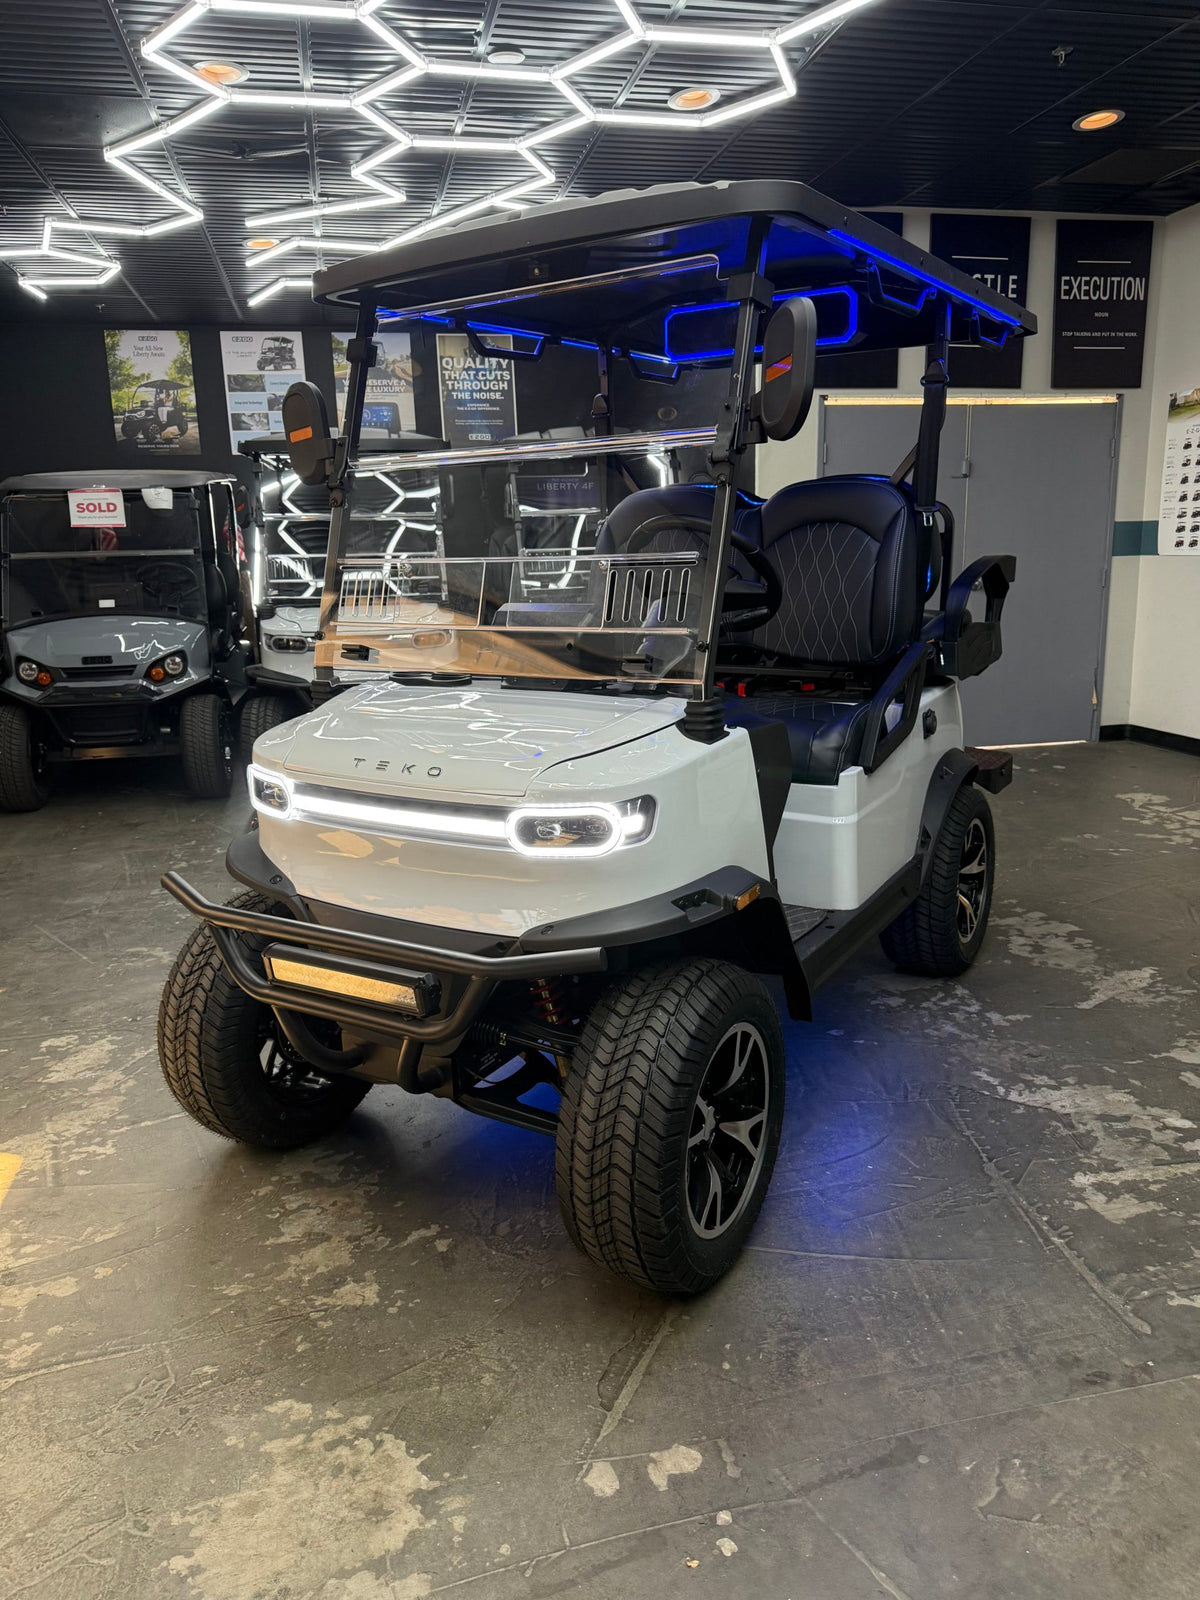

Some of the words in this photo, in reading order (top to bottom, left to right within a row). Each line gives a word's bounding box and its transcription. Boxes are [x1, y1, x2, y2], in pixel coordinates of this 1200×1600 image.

[972, 274, 1018, 298] TLE
[1060, 276, 1145, 300] EXECUTION
[441, 357, 509, 370] QUALITY
[442, 371, 476, 380] THAT
[478, 371, 511, 380] CUTS
[446, 381, 508, 390] THROUGH
[452, 392, 471, 400] THE
[473, 392, 505, 400] NOISE.
[537, 483, 579, 491] LIBERTY
[76, 502, 117, 513] SOLD
[353, 758, 442, 777] TEKO
